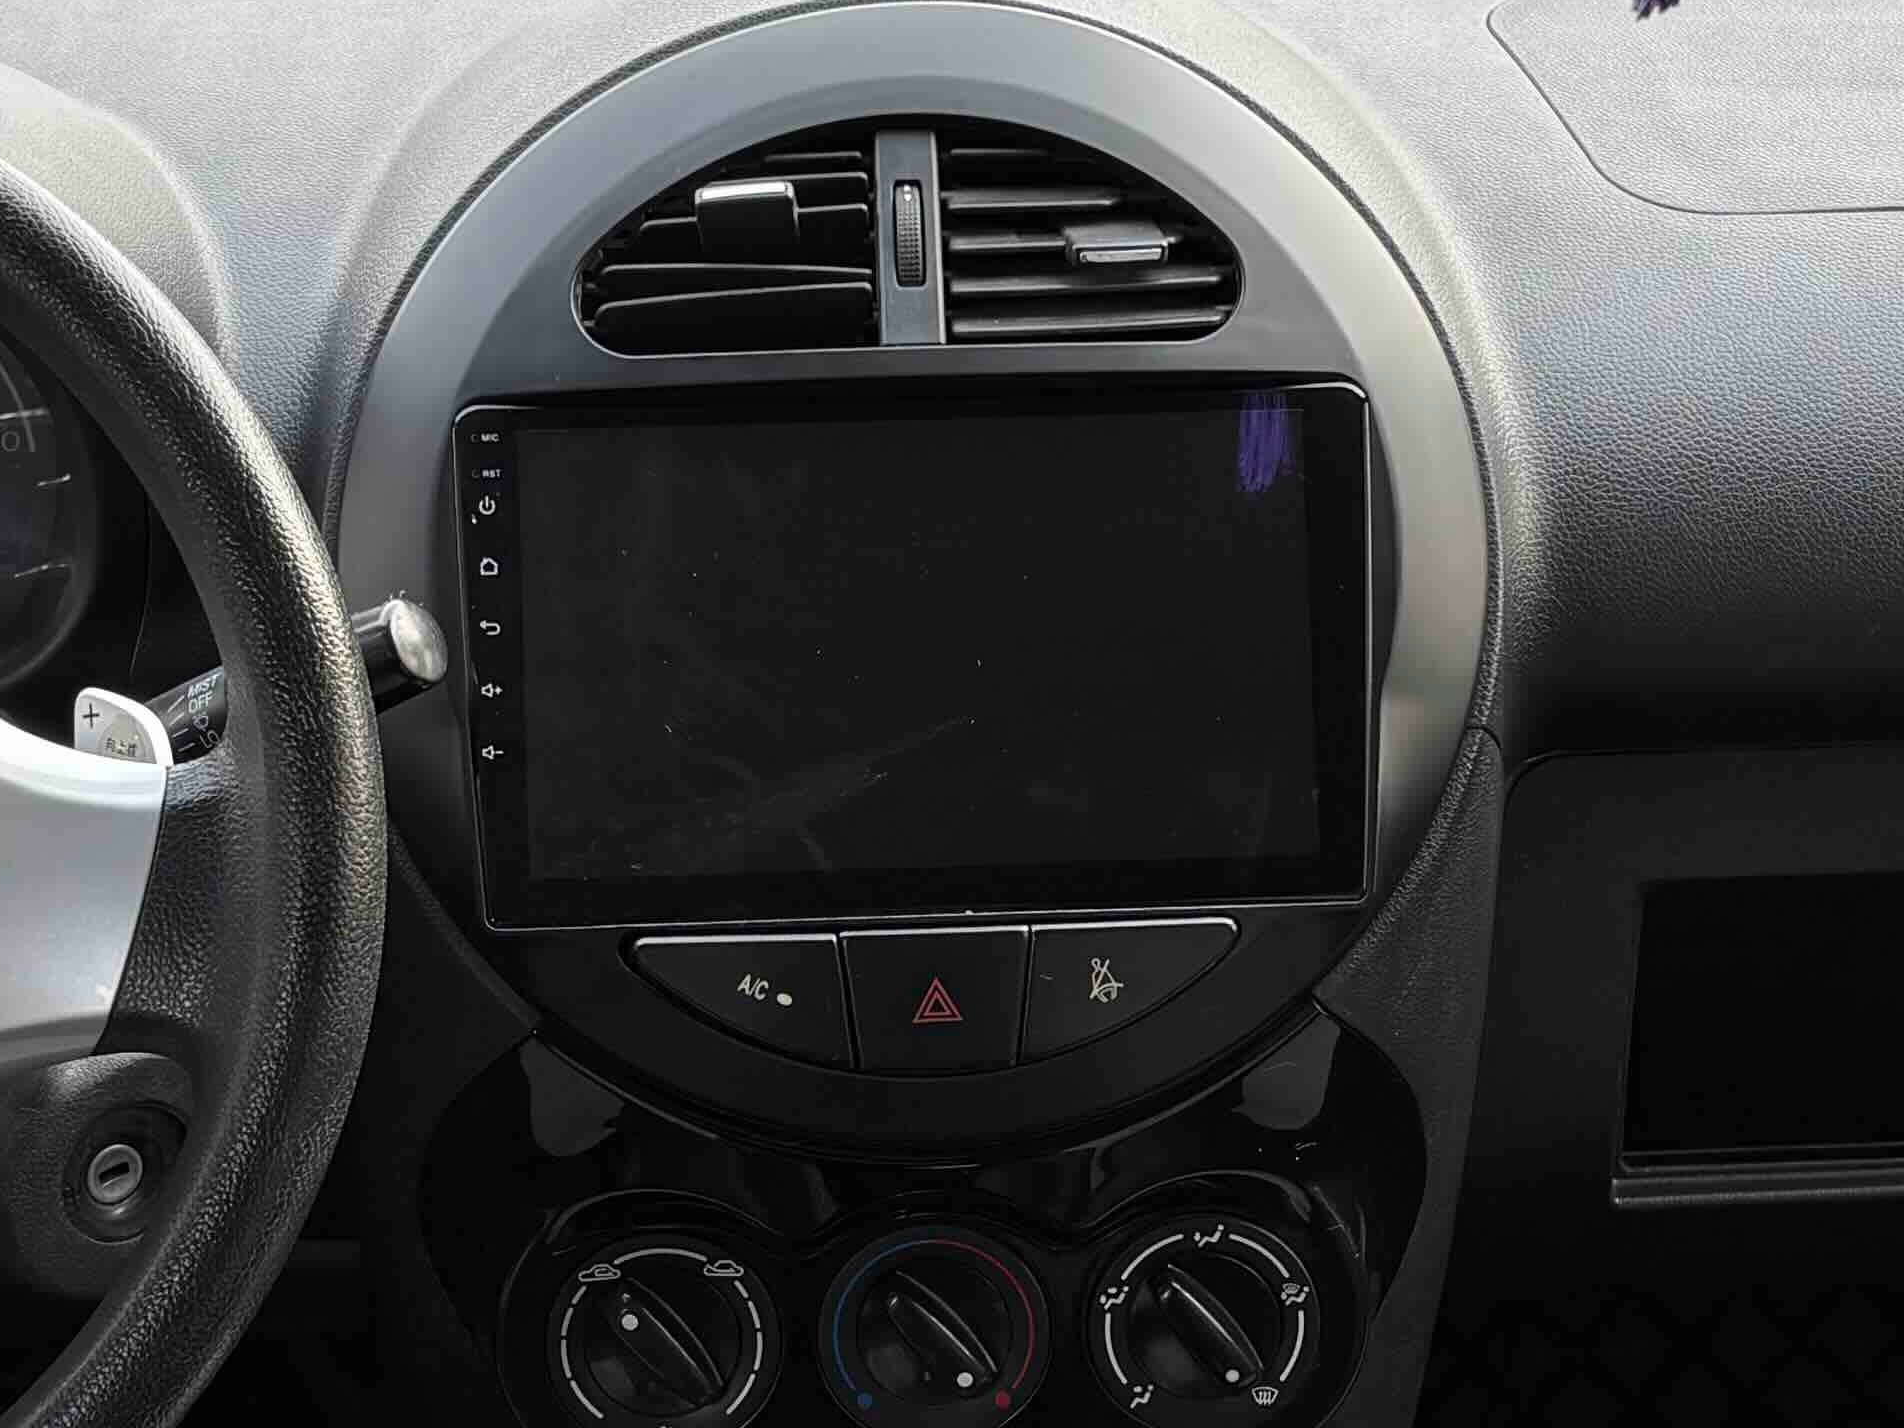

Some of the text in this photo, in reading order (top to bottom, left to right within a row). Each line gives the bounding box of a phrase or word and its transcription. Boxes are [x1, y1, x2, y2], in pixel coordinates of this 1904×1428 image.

[187, 675, 221, 699] MIST
[188, 691, 214, 714] OFF
[736, 972, 770, 1001] A/C
